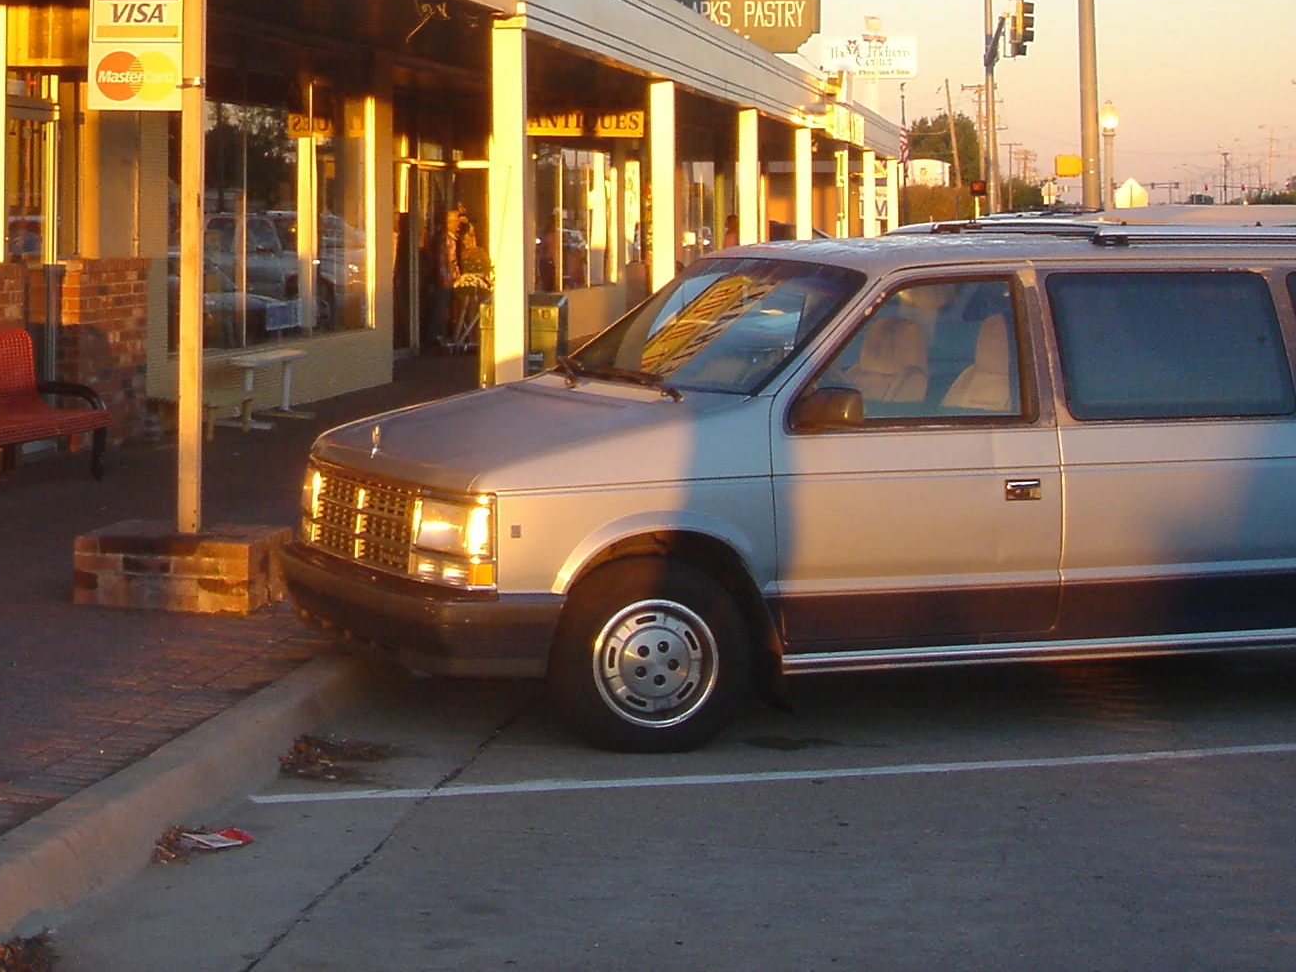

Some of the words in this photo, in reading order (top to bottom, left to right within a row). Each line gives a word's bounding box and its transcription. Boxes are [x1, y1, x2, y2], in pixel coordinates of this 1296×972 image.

[111, 3, 164, 24] VISA
[744, 0, 806, 28] PASTRY
[97, 70, 175, 84] MasterCard
